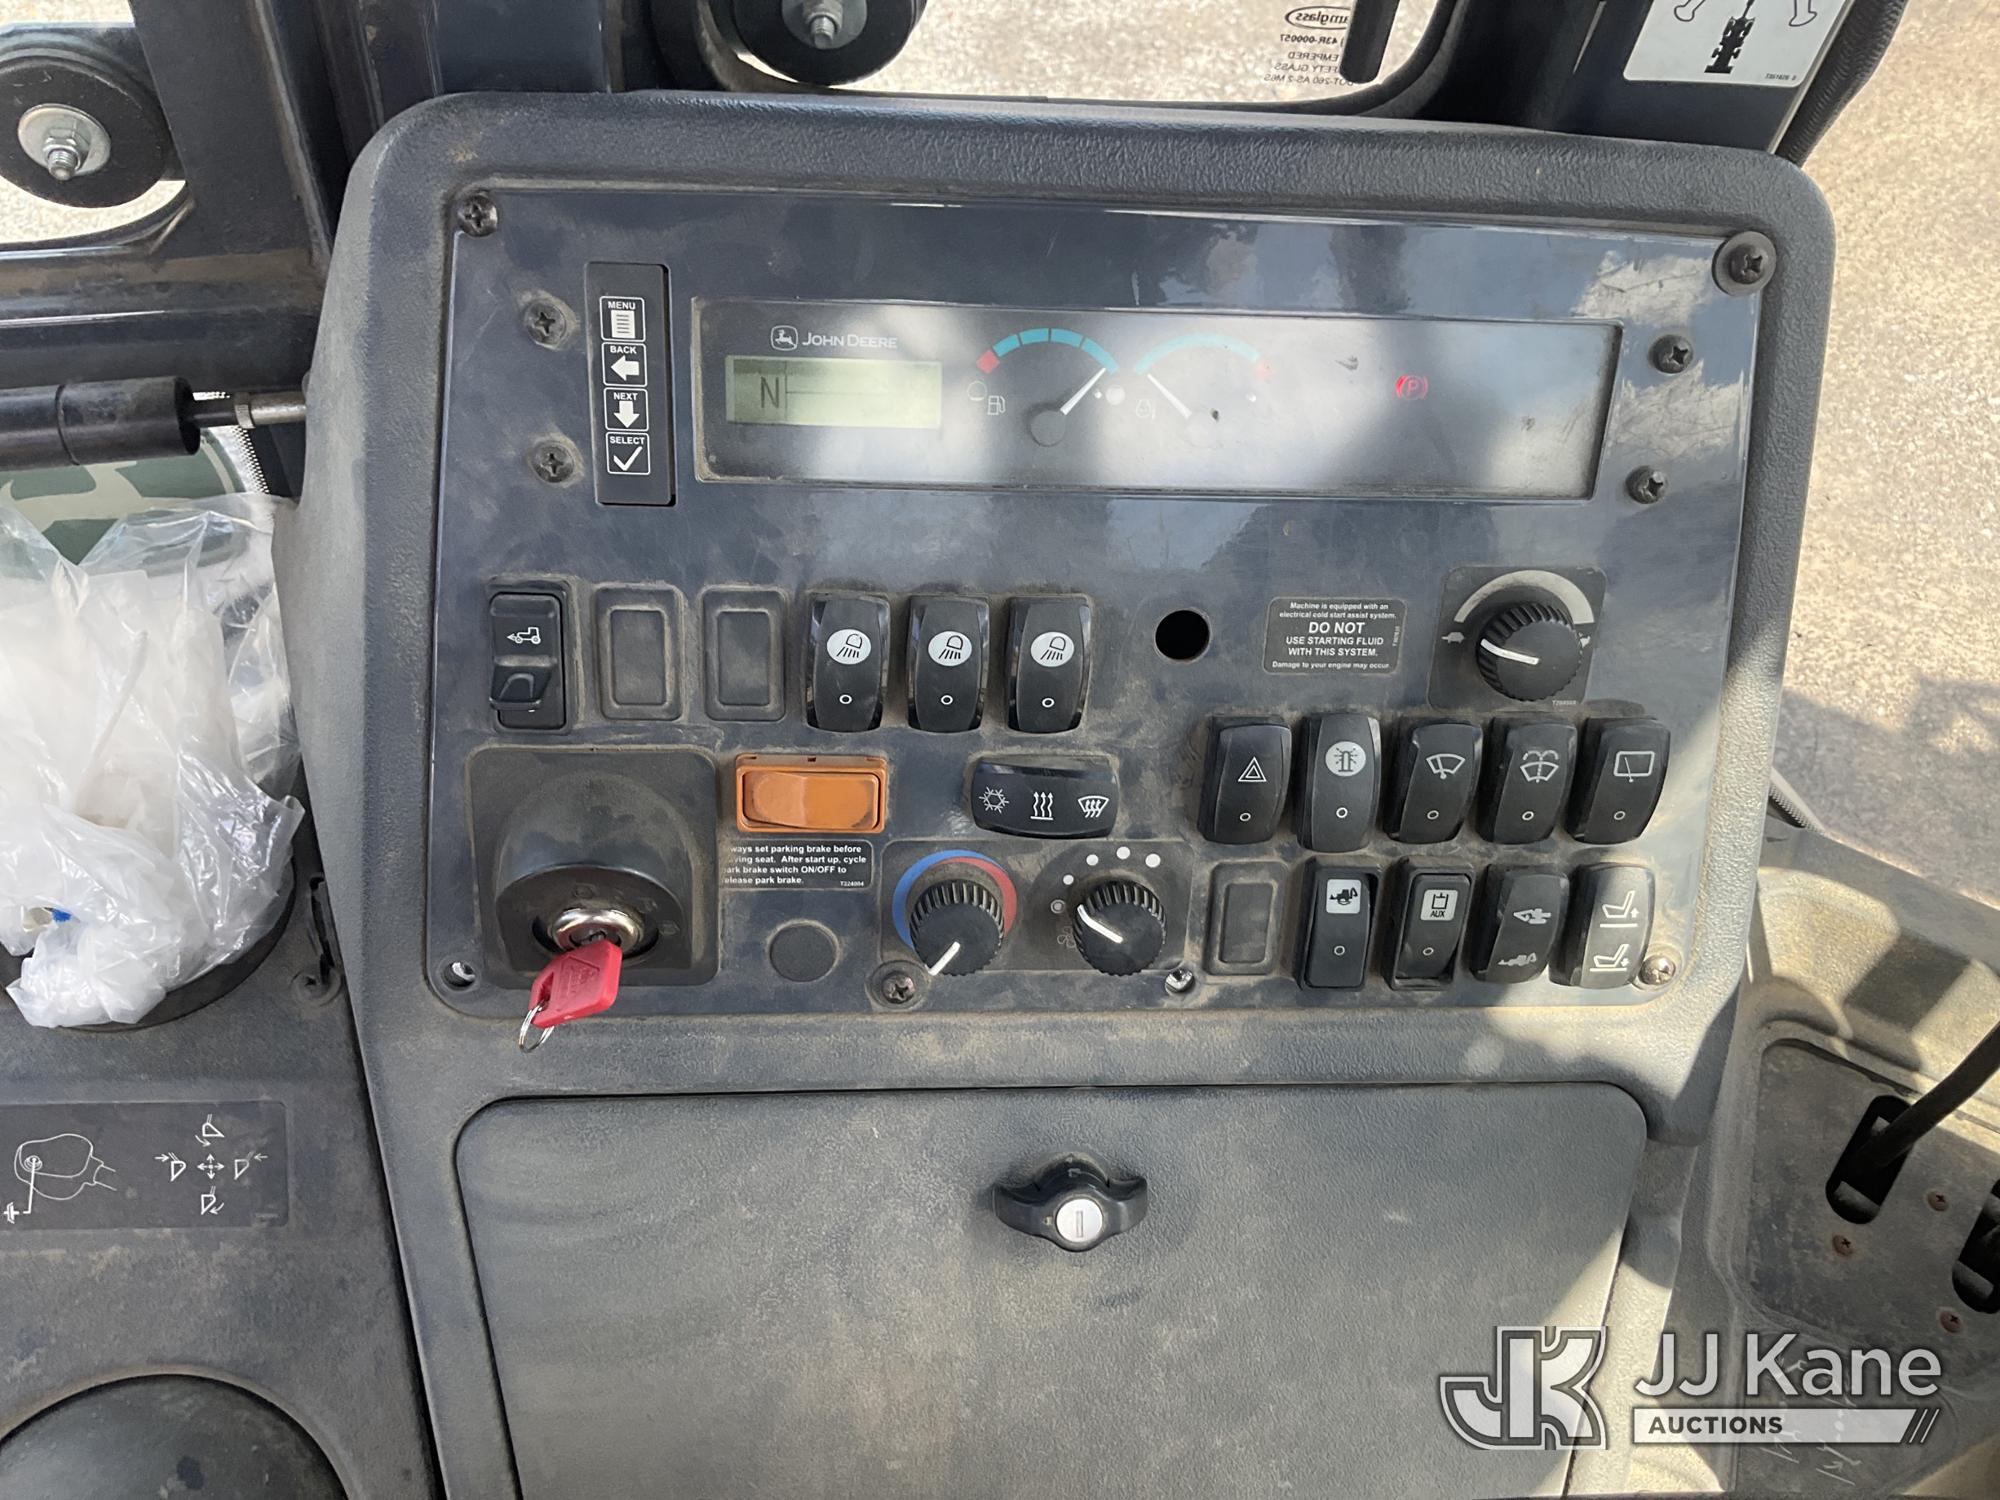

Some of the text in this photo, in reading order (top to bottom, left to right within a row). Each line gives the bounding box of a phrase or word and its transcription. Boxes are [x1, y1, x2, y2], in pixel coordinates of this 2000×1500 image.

[608, 301, 636, 310] MENU
[609, 345, 637, 354] BACK
[613, 392, 638, 400] NEXT
[760, 376, 780, 408] N
[609, 436, 646, 444] SELECT
[1329, 602, 1362, 611] equipped
[1329, 611, 1346, 619] start
[1308, 621, 1366, 634] DO NOT
[1286, 636, 1384, 645] USE STARTING FLUID
[1288, 647, 1378, 657] WITH THIS SYSTEM.
[1272, 661, 1301, 669] Damage
[754, 845, 769, 853] set
[770, 845, 805, 854] parking
[806, 845, 831, 853] brake
[833, 845, 862, 853] before
[754, 855, 777, 863] seat.
[781, 855, 803, 863] After
[843, 856, 867, 864] cycle
[755, 876, 775, 885] park
[1430, 910, 1446, 918] AUX
